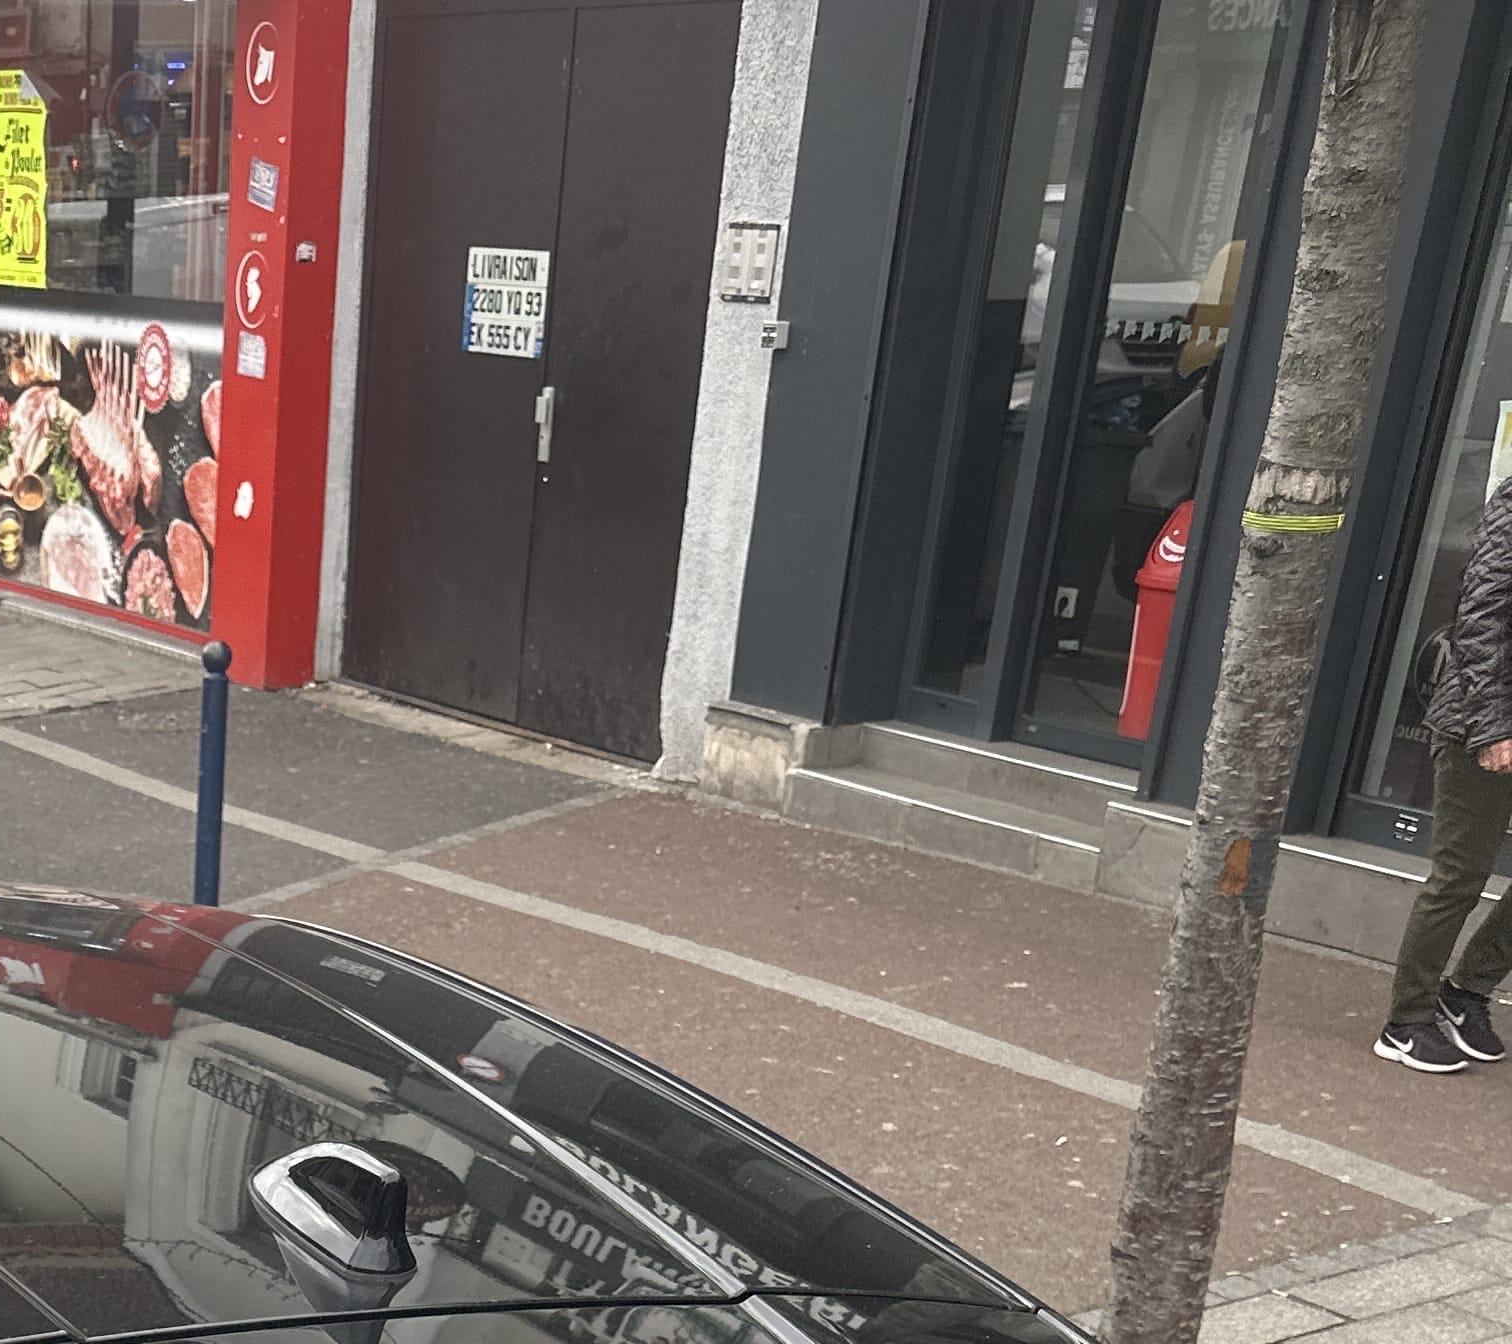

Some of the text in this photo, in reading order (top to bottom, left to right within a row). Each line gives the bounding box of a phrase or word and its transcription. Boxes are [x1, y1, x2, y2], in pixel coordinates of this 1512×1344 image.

[472, 253, 538, 281] LIVRAISON
[472, 288, 502, 314] 2280
[524, 291, 543, 317] 93
[487, 324, 511, 350] 555
[513, 326, 532, 353] CY
